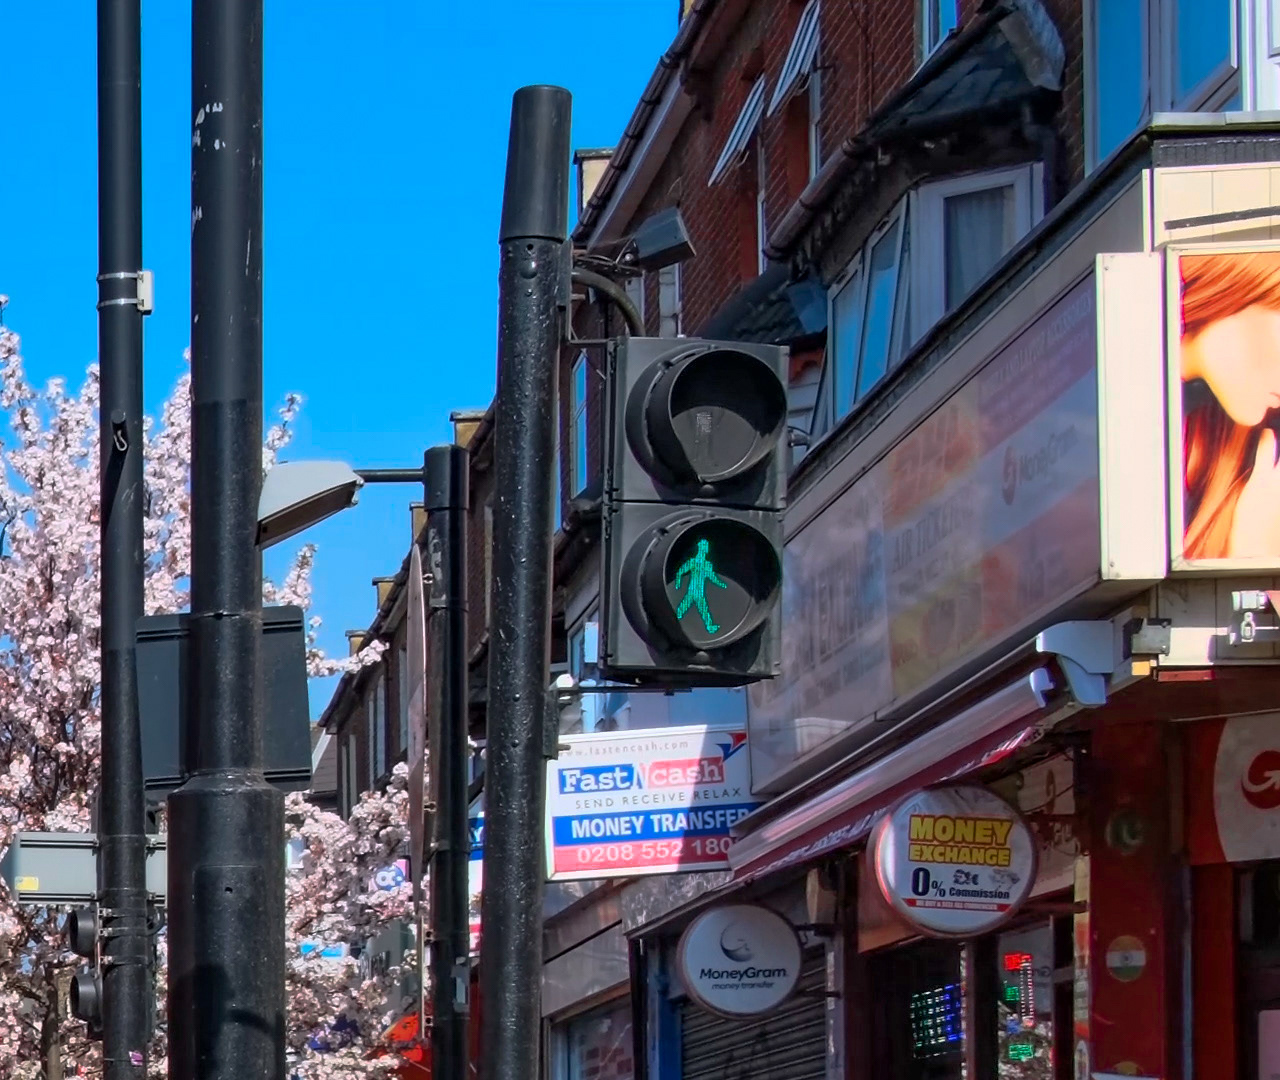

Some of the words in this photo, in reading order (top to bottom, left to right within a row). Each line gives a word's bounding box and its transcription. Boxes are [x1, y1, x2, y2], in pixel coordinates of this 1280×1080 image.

[562, 766, 631, 793] Fast
[650, 759, 723, 787] cash
[575, 799, 614, 810] SEND
[623, 791, 686, 806] RECEIVE
[694, 786, 742, 801] RELAX
[571, 815, 645, 839] MONEY
[908, 814, 1014, 846] MONEY
[576, 845, 635, 864] 0208
[642, 840, 684, 859] 552
[908, 843, 1011, 867] EXCHANGE
[949, 887, 1010, 899] Commission
[699, 966, 787, 981] MoneyGram
[712, 983, 740, 991] money
[741, 981, 774, 989] transfer
